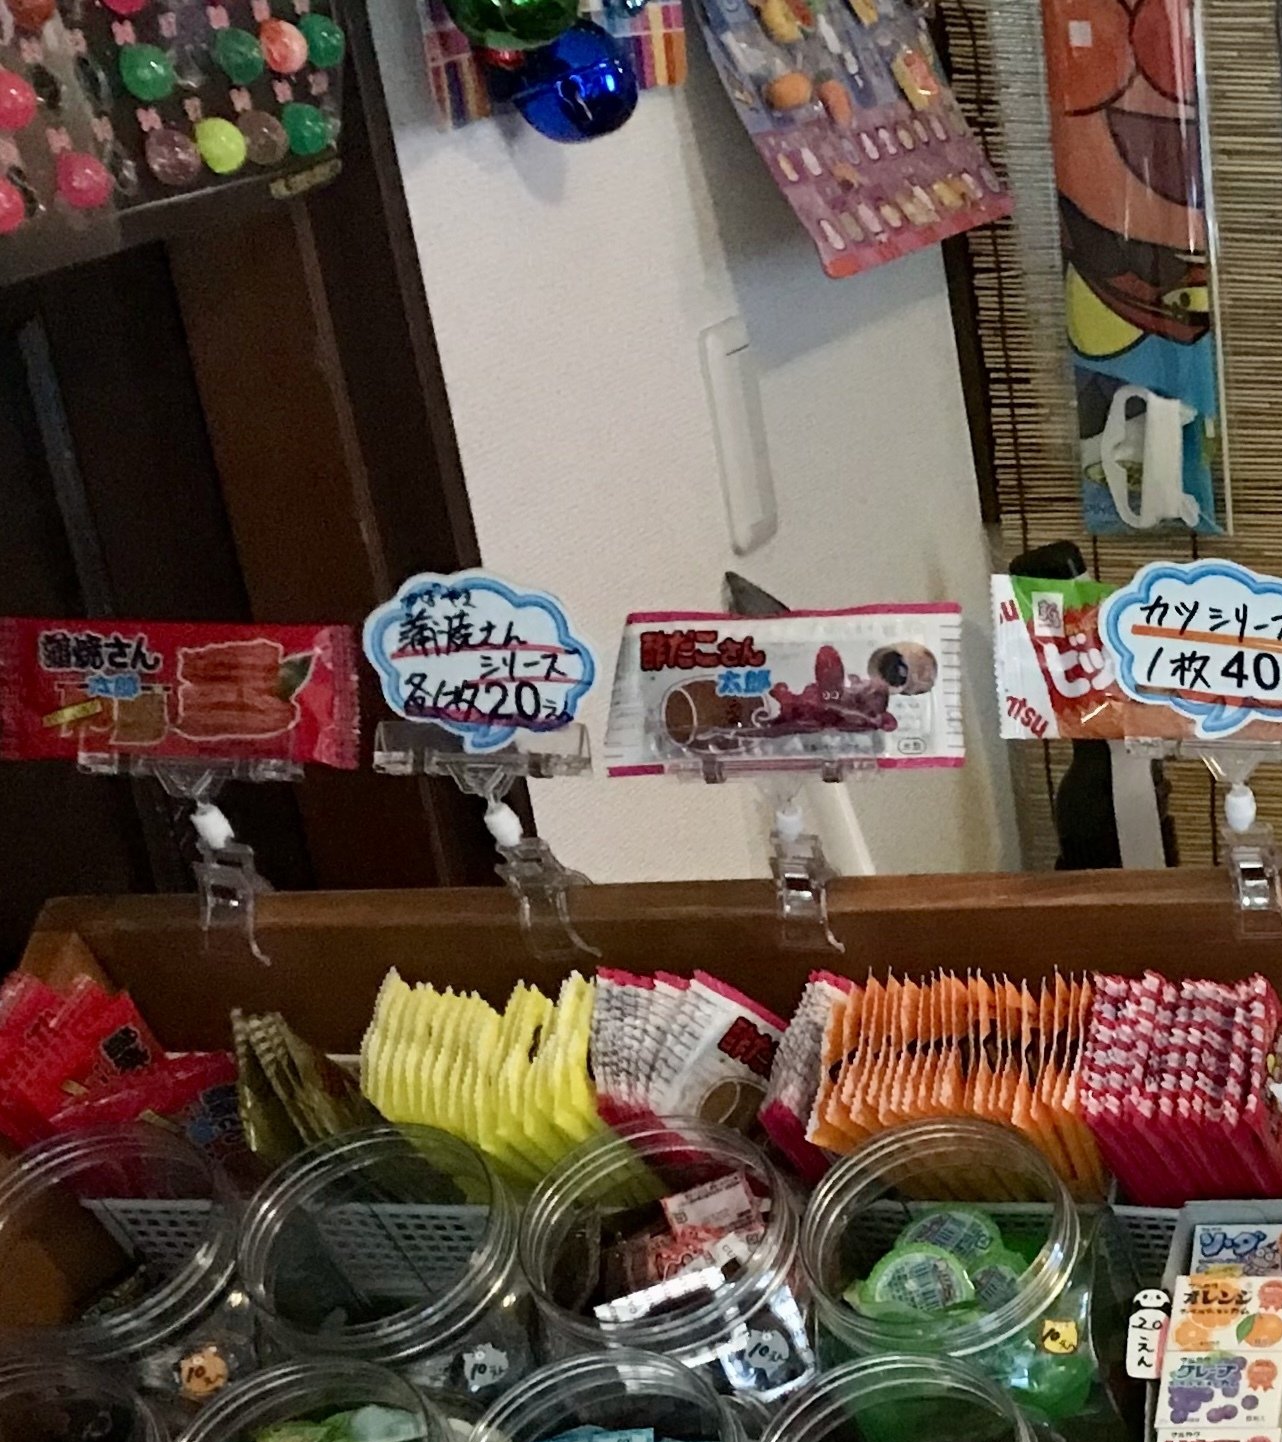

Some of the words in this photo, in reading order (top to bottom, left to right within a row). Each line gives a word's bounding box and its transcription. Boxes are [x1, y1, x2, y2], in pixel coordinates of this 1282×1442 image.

[639, 630, 767, 671] 酢だこさん
[715, 669, 772, 697] 太郎
[1183, 1289, 1254, 1307] オレンジ
[1131, 1316, 1163, 1332] 20
